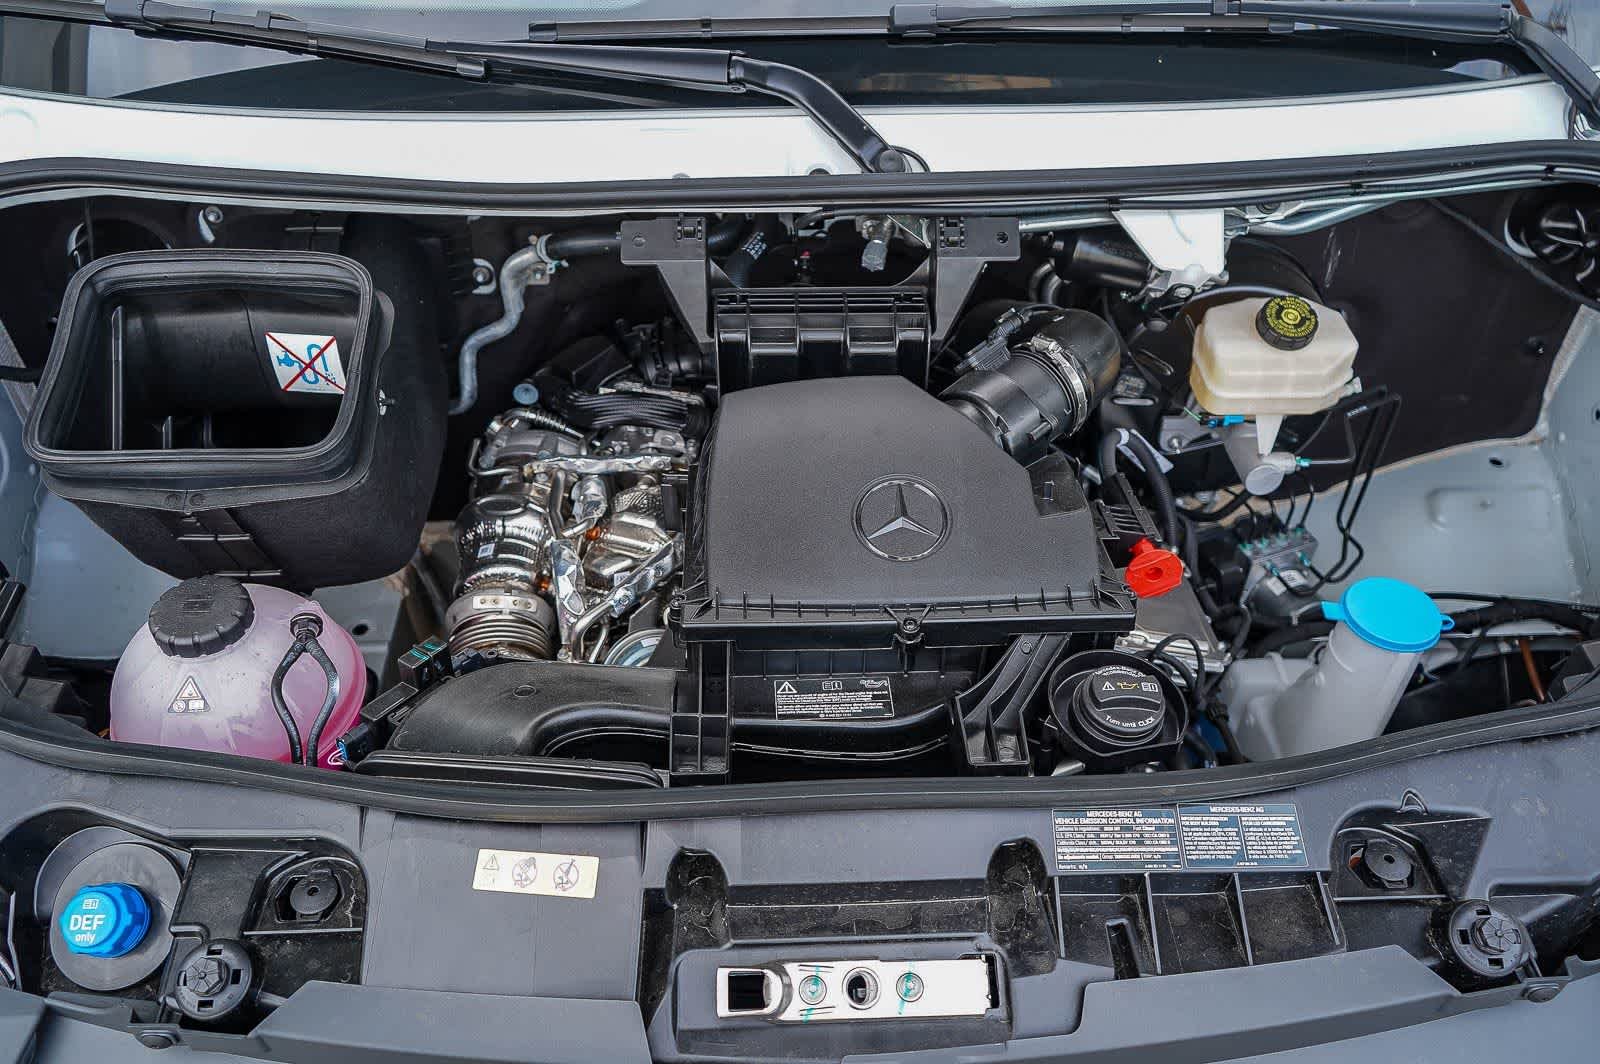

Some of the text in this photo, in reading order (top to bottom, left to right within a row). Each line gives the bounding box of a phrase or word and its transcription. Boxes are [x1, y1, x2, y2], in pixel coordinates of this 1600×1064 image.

[1105, 715, 1121, 726] Turn
[1138, 716, 1155, 727] CLICK
[1055, 817, 1174, 825] VEHICLE EMISSION CONTROL INFORMATION
[69, 914, 107, 931] DEF
[75, 931, 97, 945] only
